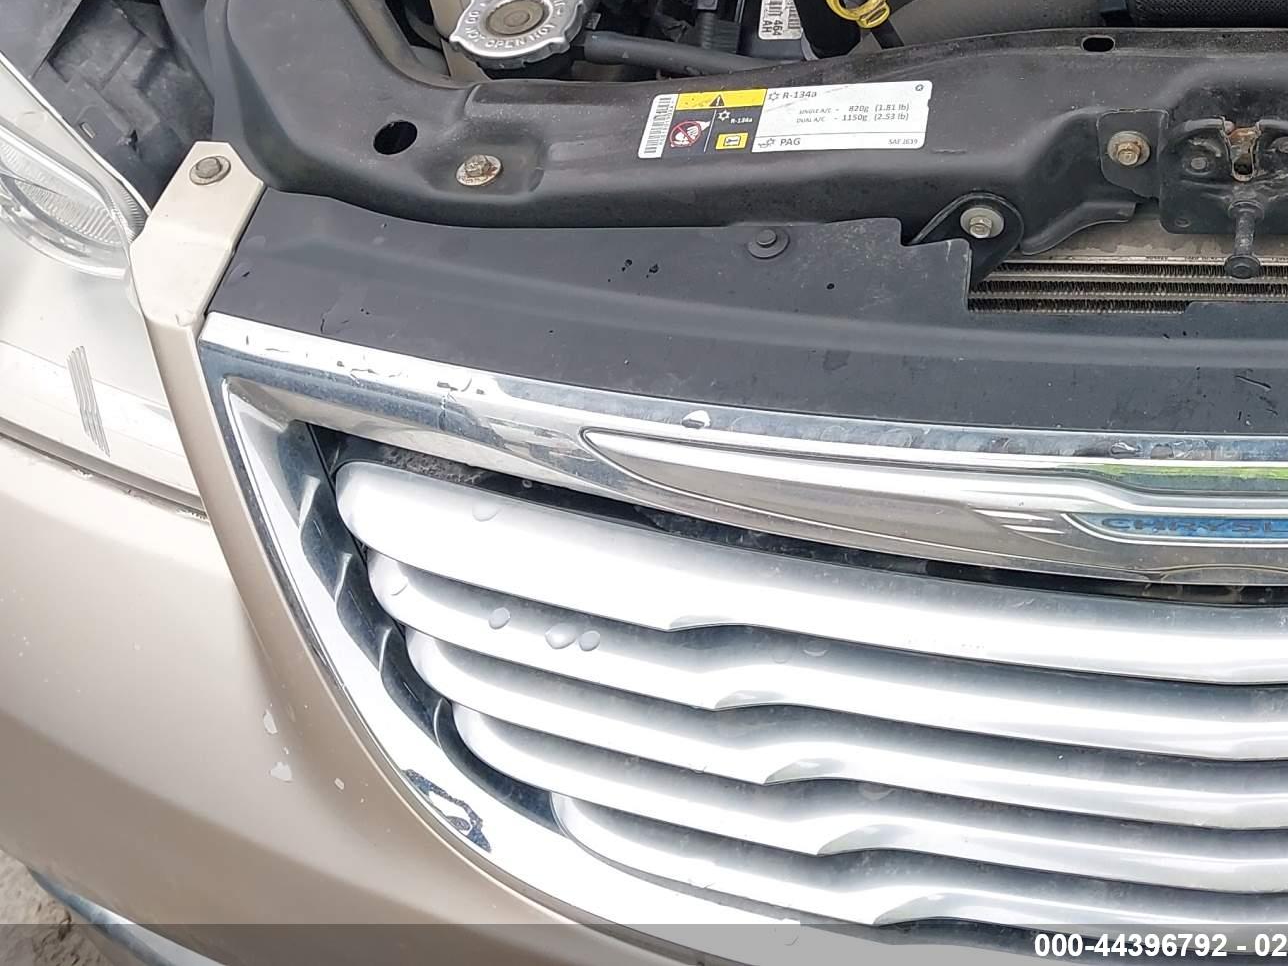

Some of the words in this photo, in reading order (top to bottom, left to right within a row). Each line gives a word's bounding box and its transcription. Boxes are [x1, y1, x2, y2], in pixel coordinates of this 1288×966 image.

[782, 90, 817, 99] R-134a
[848, 104, 870, 114] 820g
[874, 103, 897, 113] (1.81
[898, 103, 910, 112] lb)
[873, 113, 896, 122] (2.53
[897, 112, 910, 121] lb)
[780, 137, 801, 146] PAG
